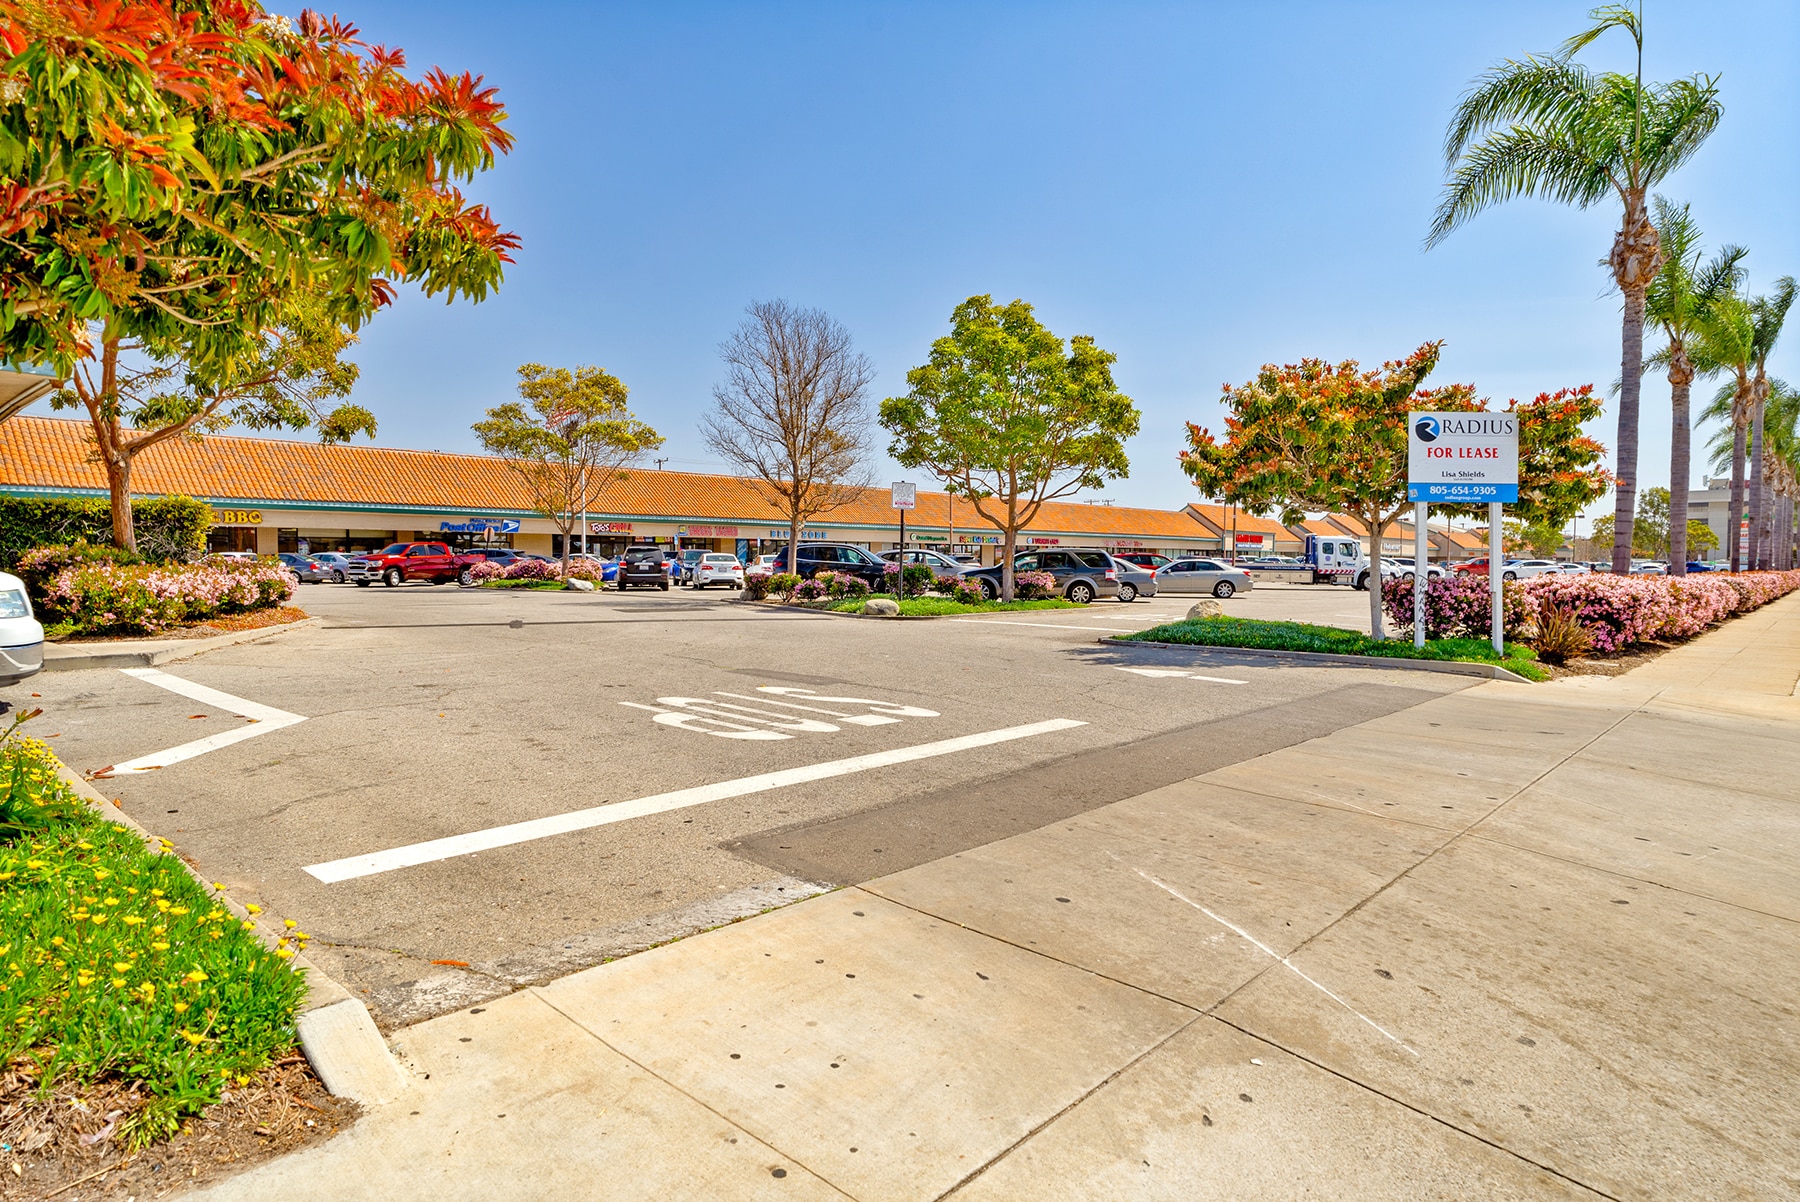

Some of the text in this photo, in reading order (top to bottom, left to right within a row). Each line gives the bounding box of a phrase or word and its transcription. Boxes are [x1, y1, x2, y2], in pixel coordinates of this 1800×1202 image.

[1442, 419, 1513, 434] RADIUS
[1427, 447, 1499, 458] FOR LEASE
[1429, 486, 1497, 495] 805-654-9305
[223, 510, 263, 524] BBQ
[440, 522, 500, 532] Post Offie
[770, 530, 828, 539] BLU ZONE
